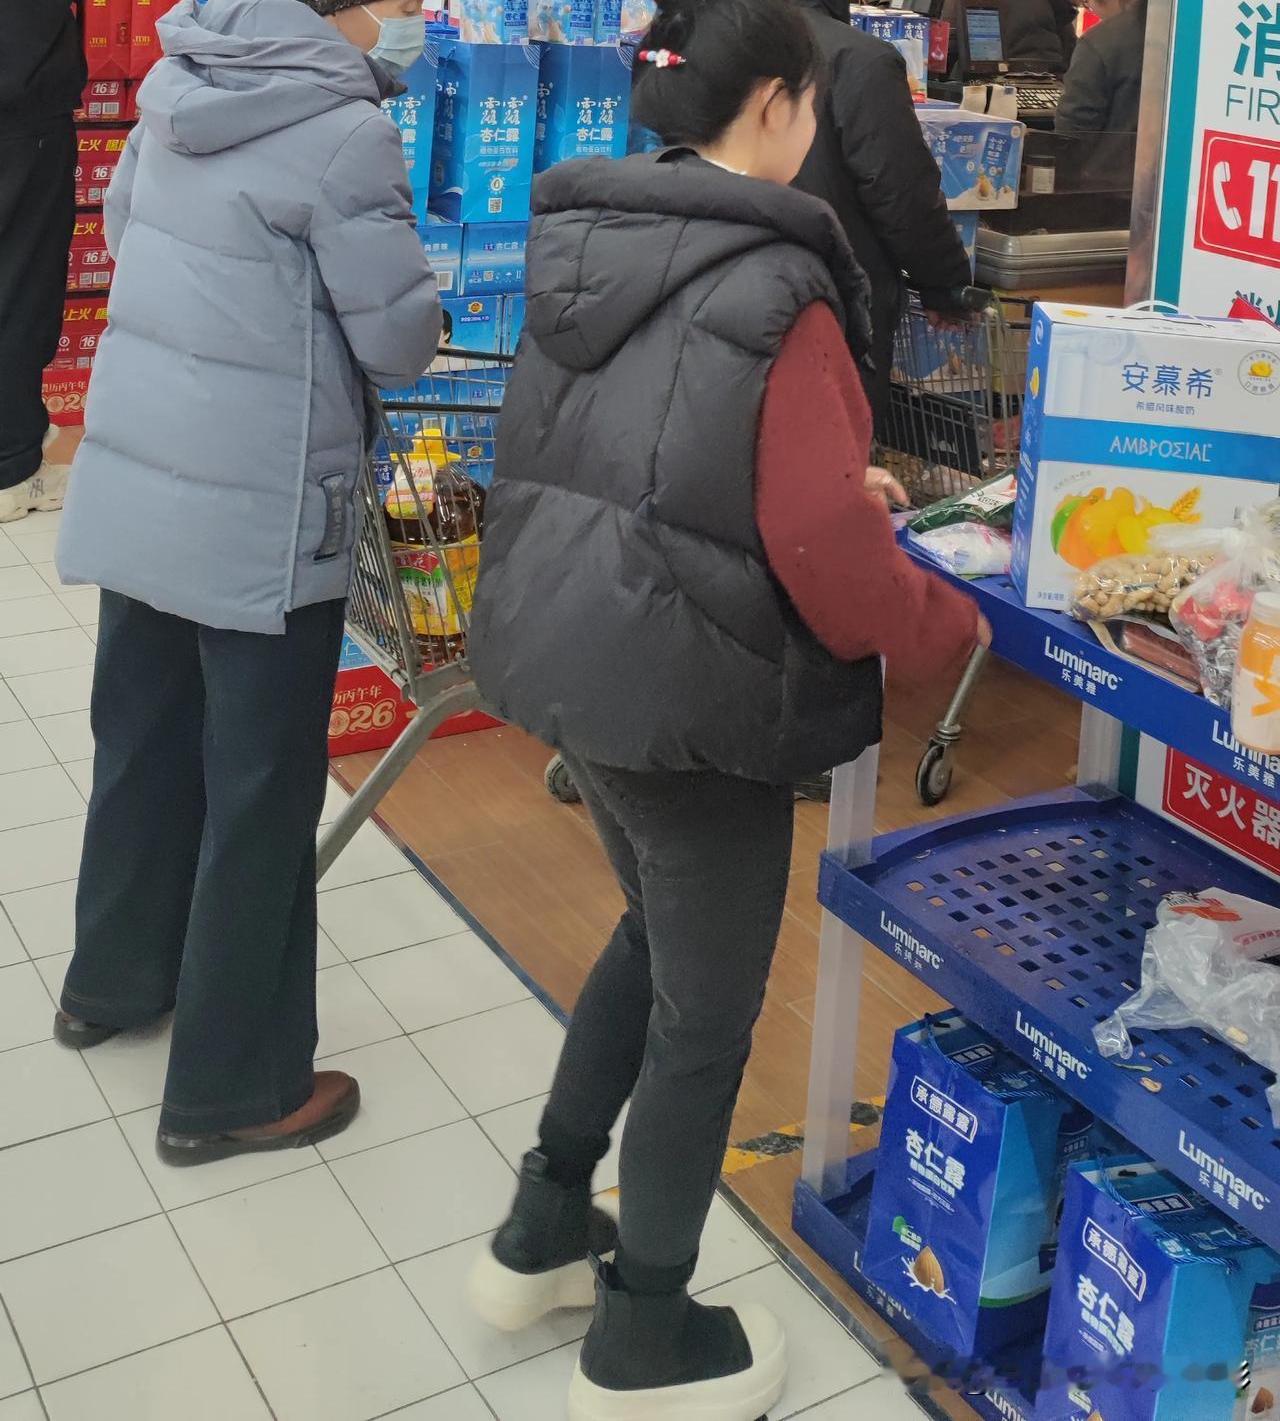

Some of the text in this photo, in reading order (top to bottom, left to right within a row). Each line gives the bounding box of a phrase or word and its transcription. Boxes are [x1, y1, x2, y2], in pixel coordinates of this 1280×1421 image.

[94, 83, 107, 94] 16
[480, 128, 520, 142] 杏仁露
[576, 127, 614, 141] 杏仁露
[93, 167, 107, 178] 16
[85, 252, 98, 263] 16
[81, 336, 95, 347] 16
[1121, 362, 1214, 399] 安慕希
[1044, 636, 1119, 690] Luminarc
[1233, 756, 1275, 789] 乐美雅
[1182, 763, 1280, 850] 灭火器
[880, 910, 940, 969] Luminarc
[1016, 1010, 1088, 1080] Luminarc
[905, 1128, 966, 1190] 杏仁露
[1179, 1130, 1264, 1210] Luminarc
[1077, 1274, 1136, 1354] 杏仁露
